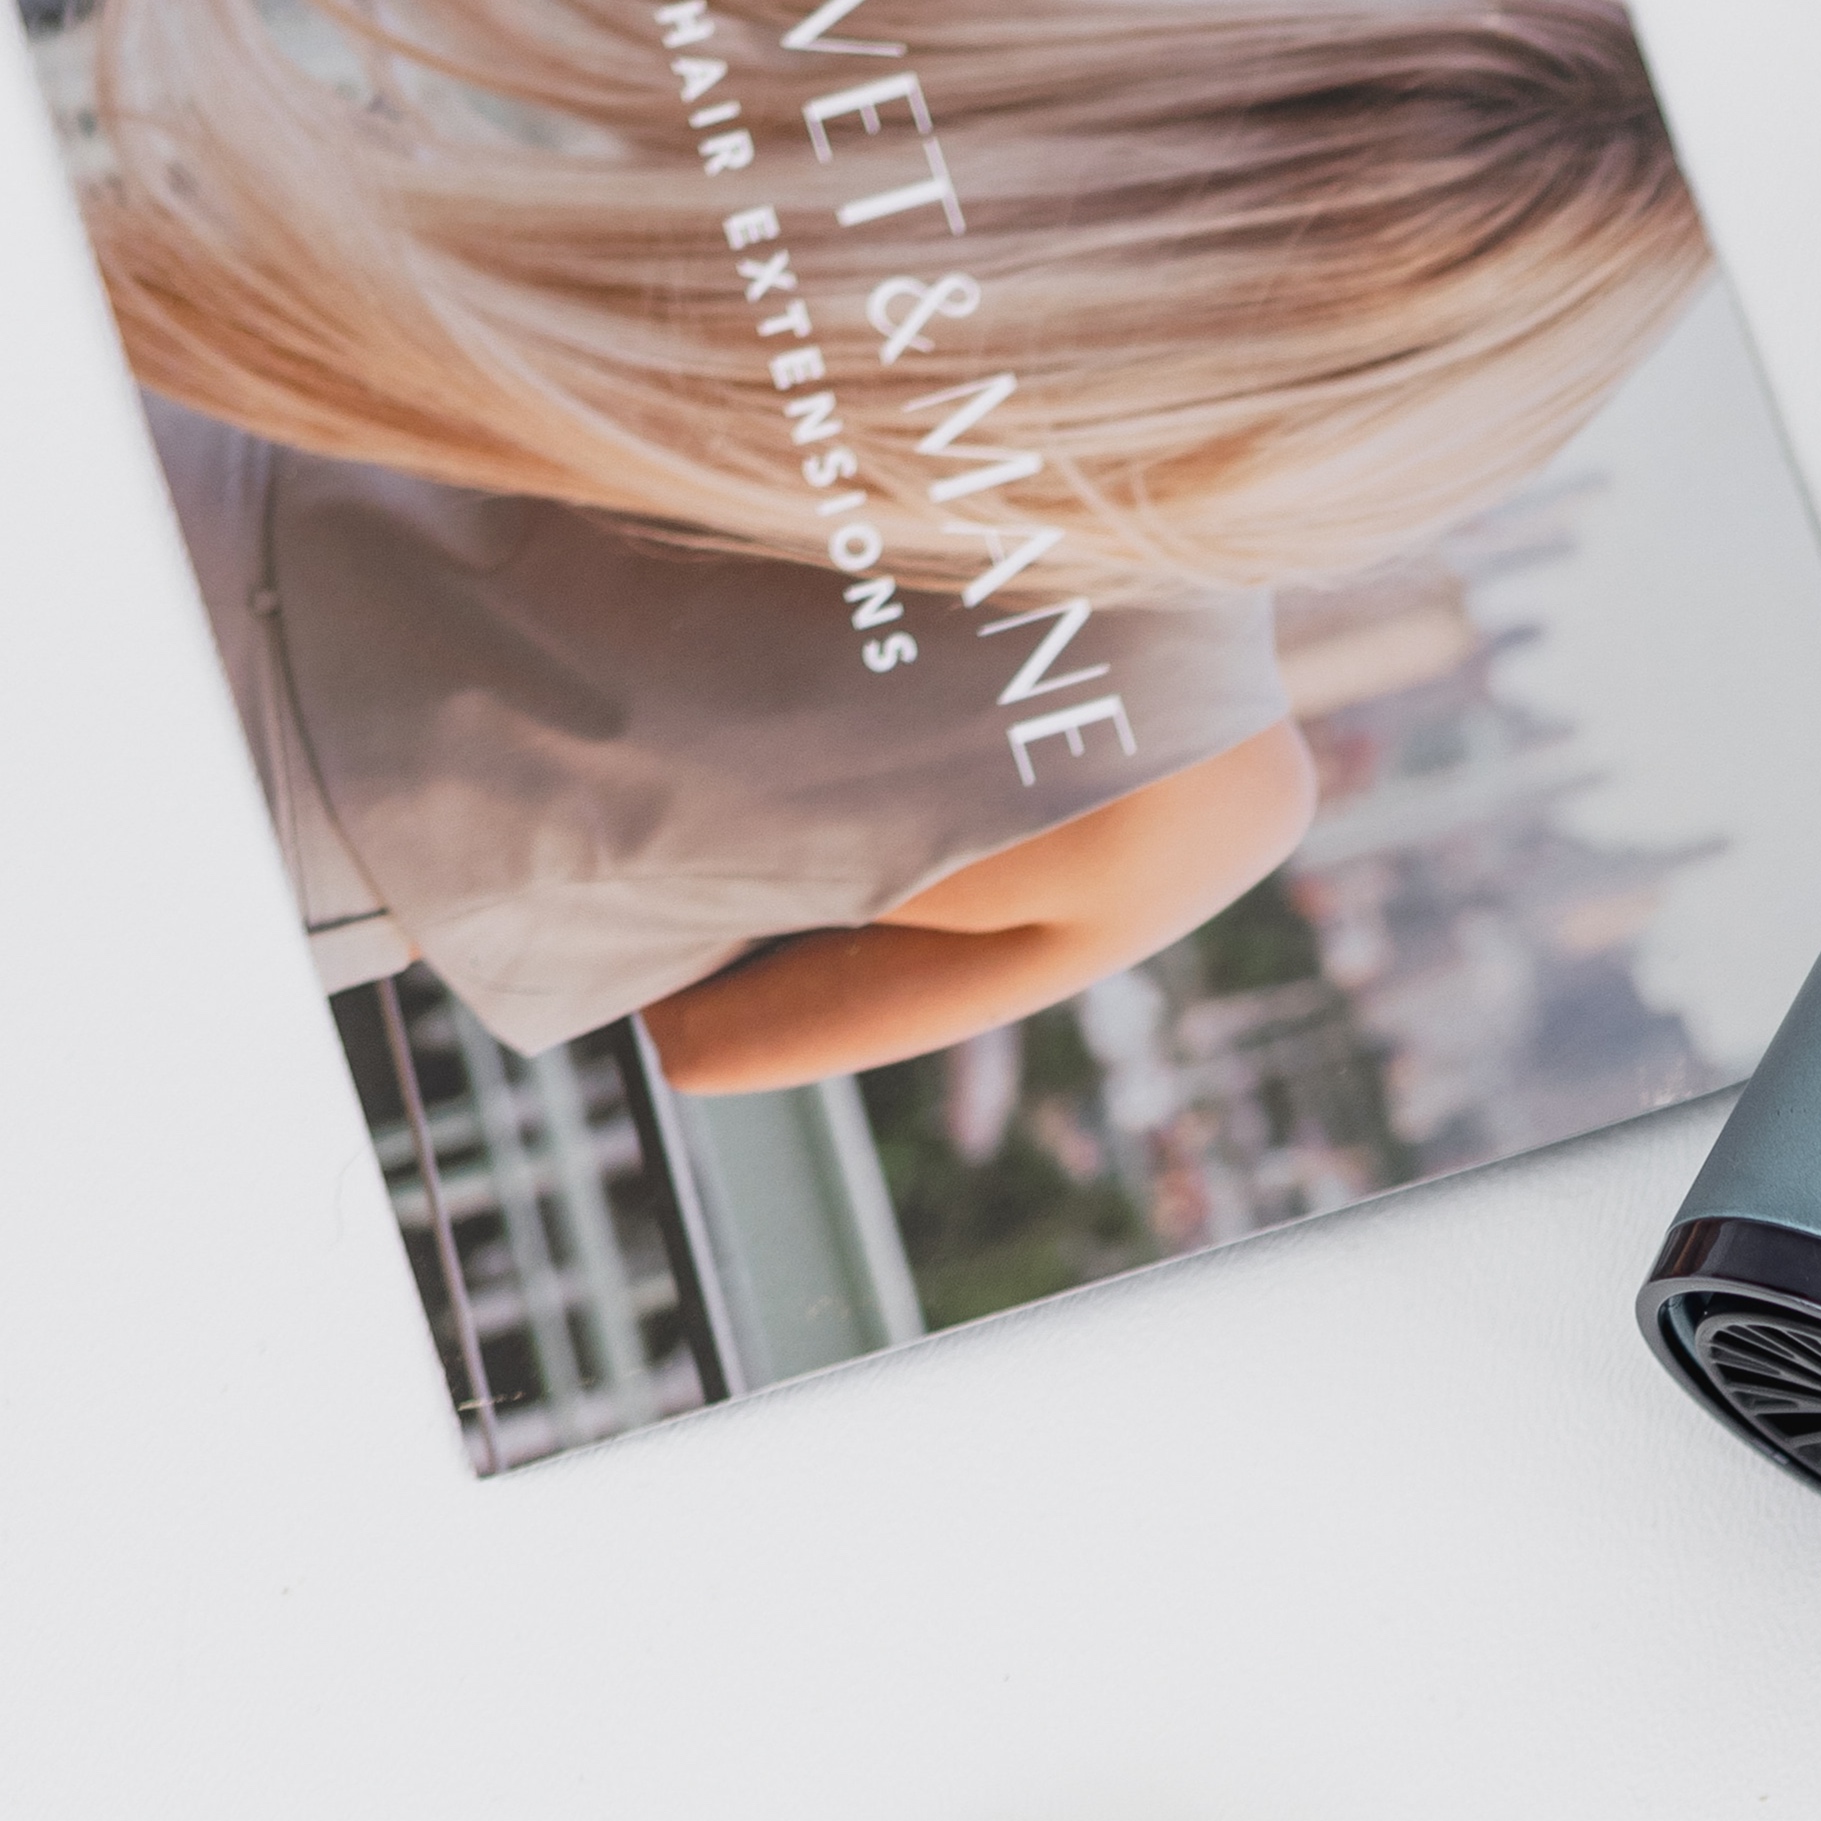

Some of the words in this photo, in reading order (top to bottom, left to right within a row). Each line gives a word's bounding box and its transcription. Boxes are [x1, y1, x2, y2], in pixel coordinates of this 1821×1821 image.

[654, 0, 755, 178] HAIR
[722, 204, 918, 673] EXTENSIONS
[866, 272, 982, 366] &
[901, 373, 1138, 787] MANE
